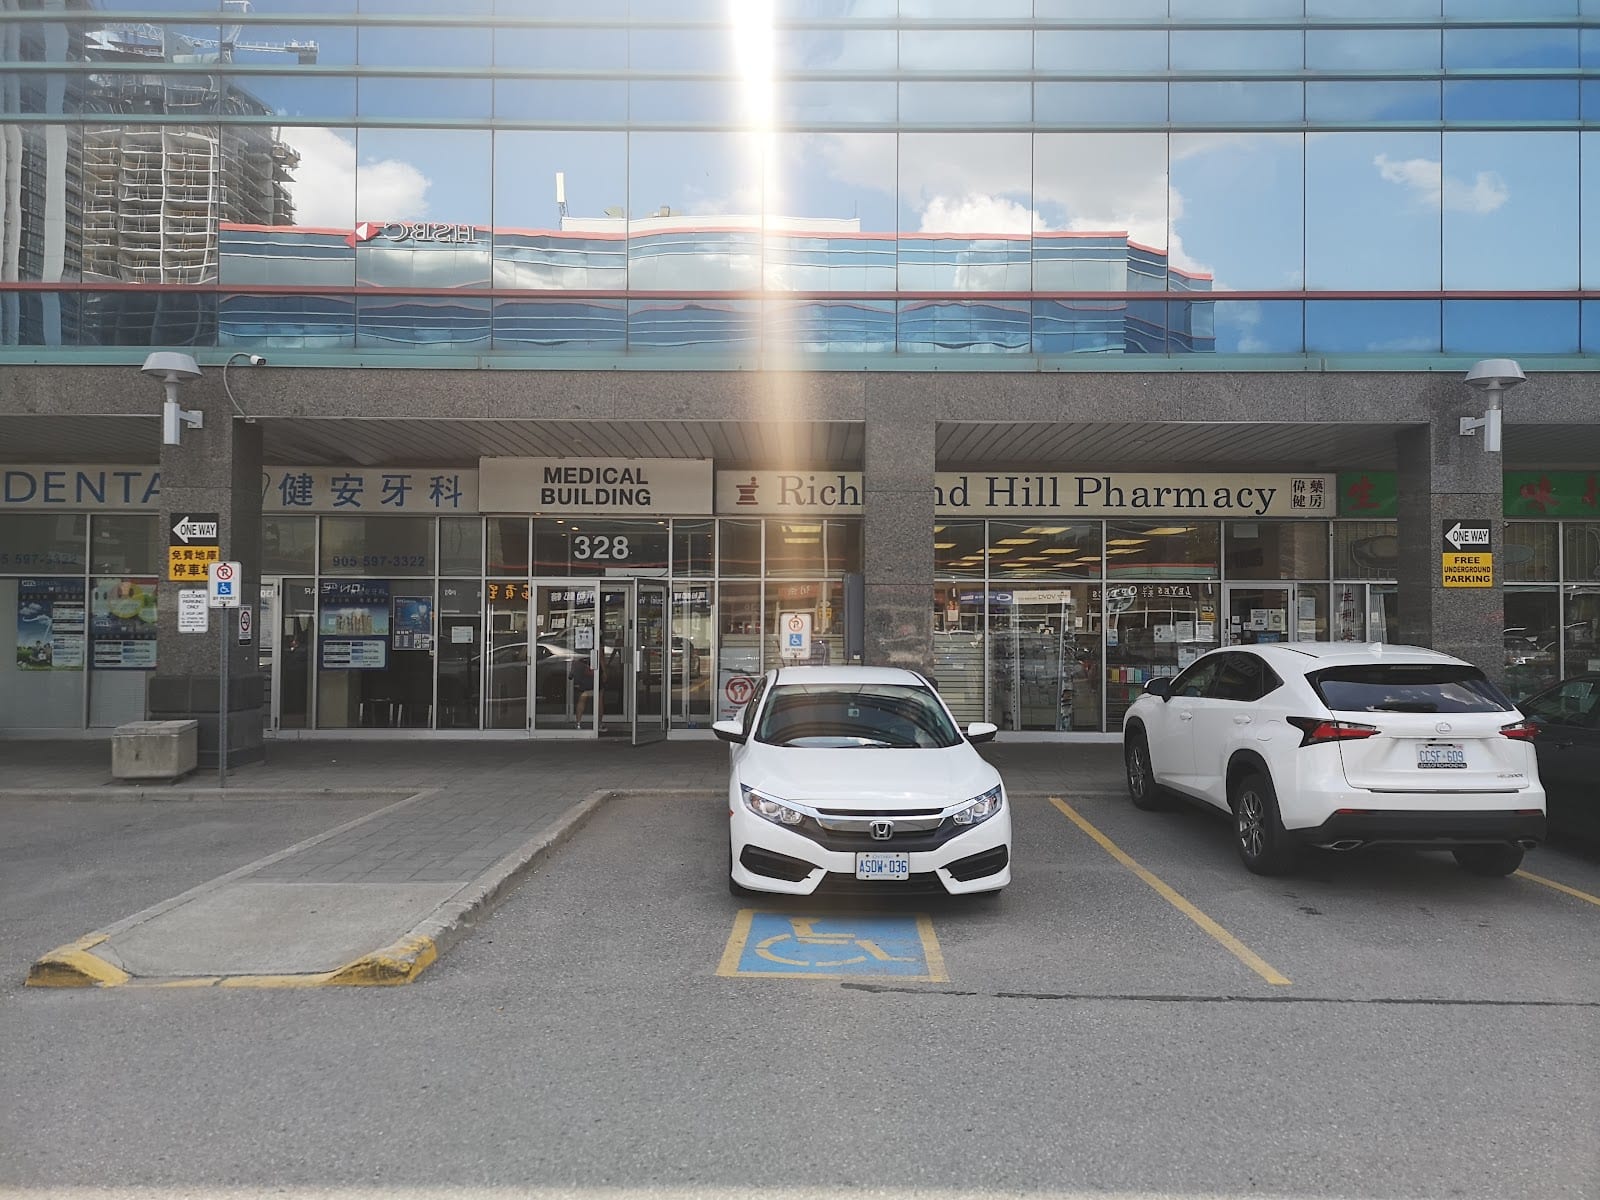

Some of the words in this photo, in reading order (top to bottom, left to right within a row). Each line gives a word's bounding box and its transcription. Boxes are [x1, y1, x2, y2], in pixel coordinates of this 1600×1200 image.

[543, 467, 649, 485] MEDICAL
[4, 471, 160, 503] DENTA
[278, 472, 463, 507] 健安牙科
[541, 488, 651, 506] BUILDING
[985, 476, 1060, 507] Hill
[1074, 477, 1277, 515] Pharmacy
[180, 524, 197, 536] ONE
[198, 524, 216, 536] WAY
[1452, 530, 1469, 542] ONE
[1470, 530, 1488, 542] WAY
[574, 535, 629, 560] 328
[332, 555, 357, 567] 905
[363, 555, 425, 567] 597-3322
[1454, 556, 1481, 564] FREE
[1445, 575, 1490, 583] PARKING
[1420, 750, 1441, 762] CCSF
[1447, 750, 1464, 762] 609
[860, 860, 883, 873] ASDW
[889, 860, 907, 873] 036
